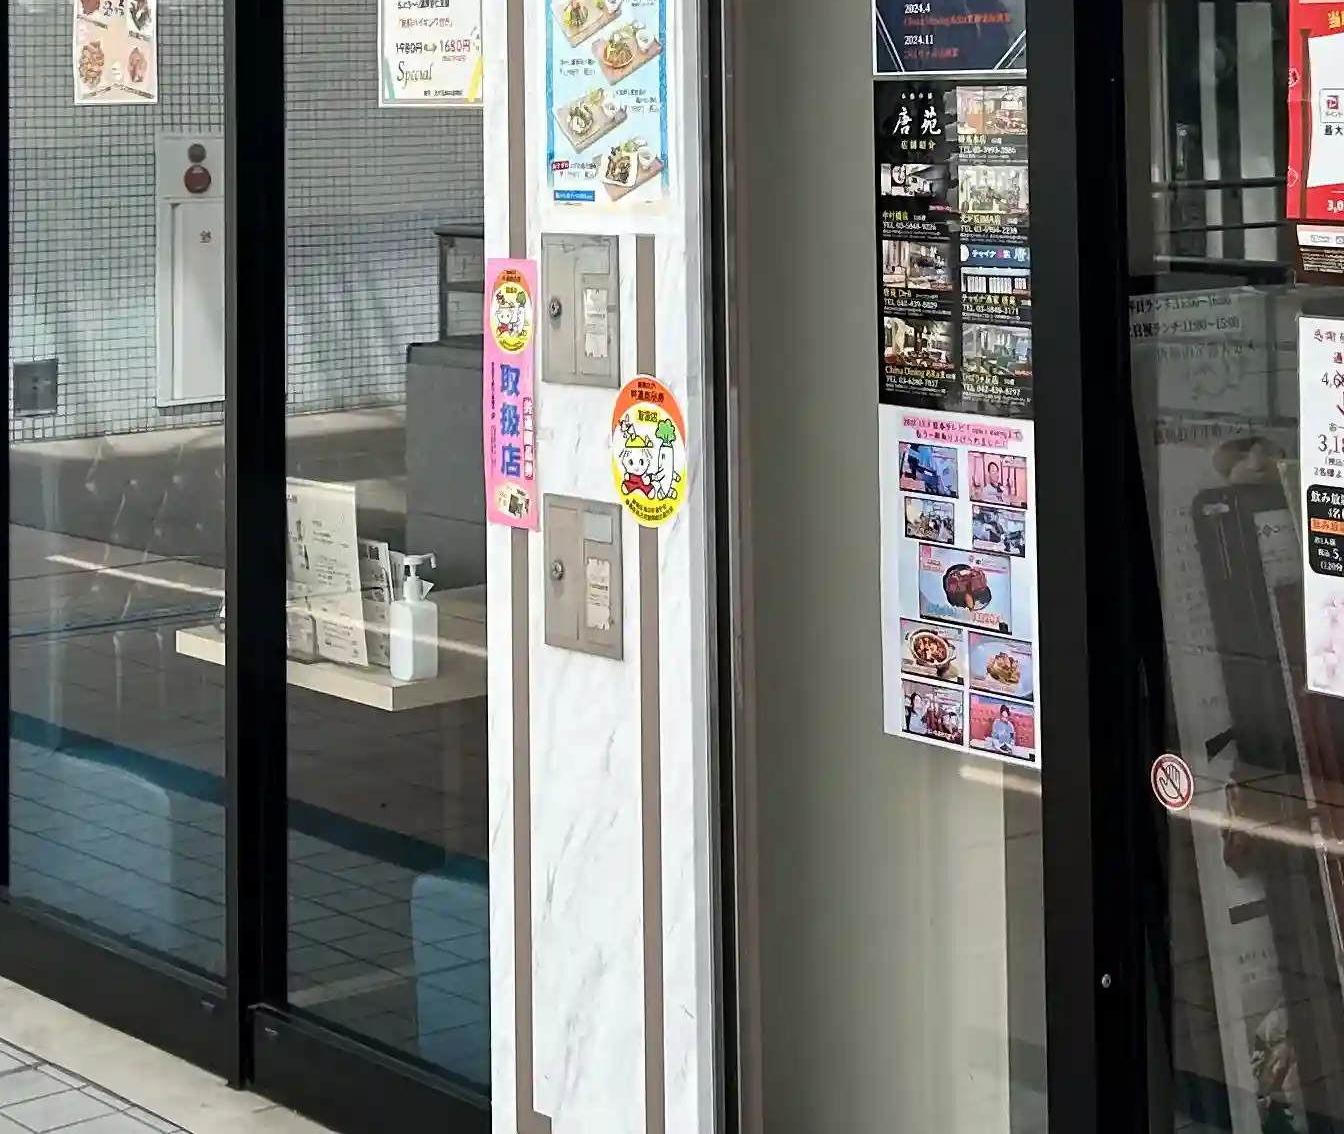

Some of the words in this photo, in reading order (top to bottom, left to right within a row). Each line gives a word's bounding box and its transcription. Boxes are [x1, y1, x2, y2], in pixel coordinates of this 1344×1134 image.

[904, 2, 932, 14] 2024.4
[903, 34, 935, 45] 2024.11
[892, 106, 942, 135] 唐苑
[1324, 124, 1344, 136] 最大
[499, 363, 522, 479] 取扱店
